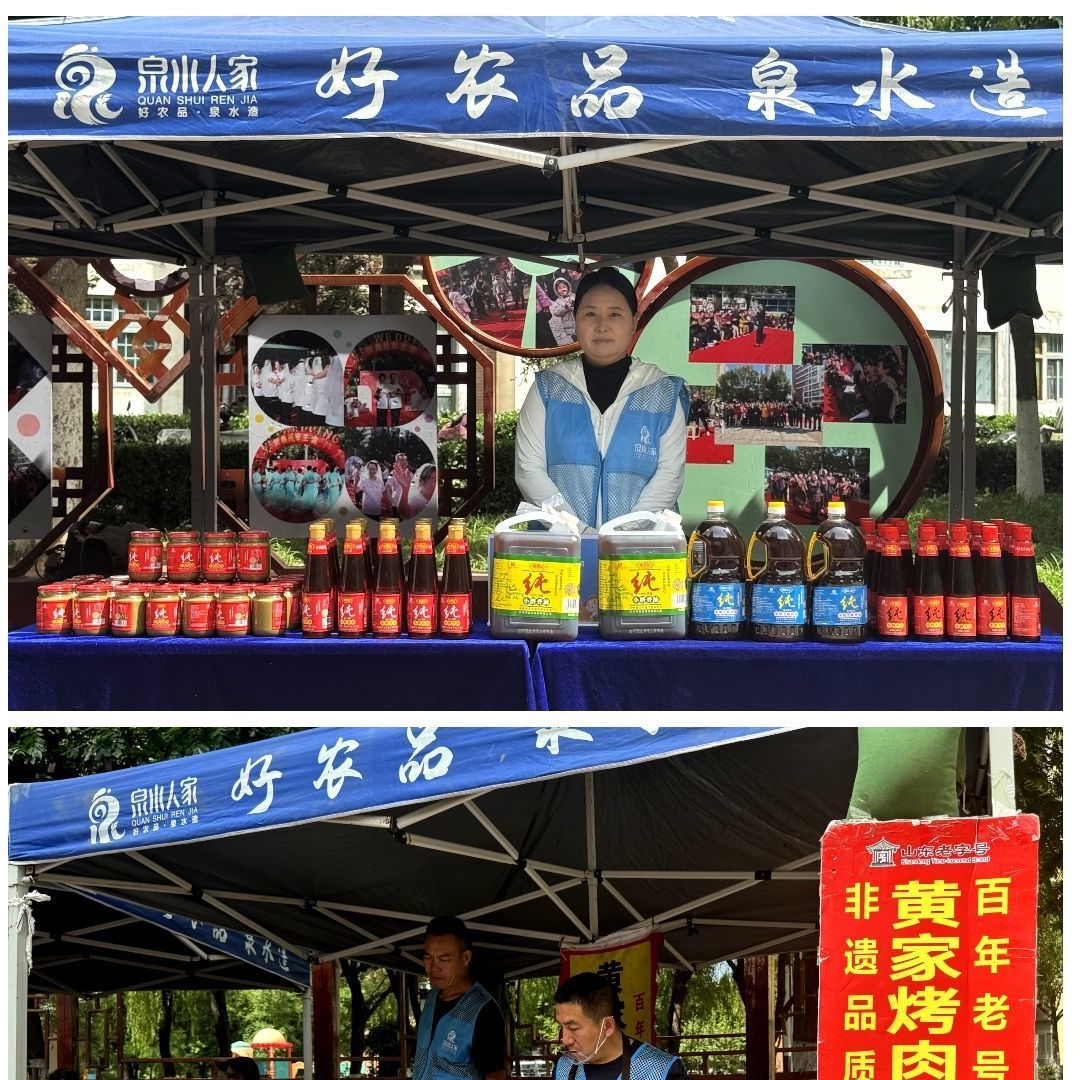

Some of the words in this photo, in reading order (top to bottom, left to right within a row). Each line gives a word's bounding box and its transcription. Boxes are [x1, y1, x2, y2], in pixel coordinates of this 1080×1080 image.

[138, 54, 258, 93] 泉水人家
[316, 44, 643, 120] 好农品
[747, 47, 1048, 120] 泉水造
[137, 96, 171, 105] QUAN
[177, 96, 206, 105] SHUI
[211, 95, 238, 104] REN
[240, 95, 258, 104] JIA
[523, 573, 551, 595] 纯
[631, 571, 660, 594] 纯
[230, 727, 456, 815] 好农品
[131, 776, 199, 818] 泉水人家
[131, 817, 150, 827] QUAN
[153, 813, 168, 823] SHUI
[171, 809, 185, 818] REN
[188, 806, 198, 815] JIA
[901, 842, 990, 857] 山东老字号
[632, 992, 646, 1038] 百年
